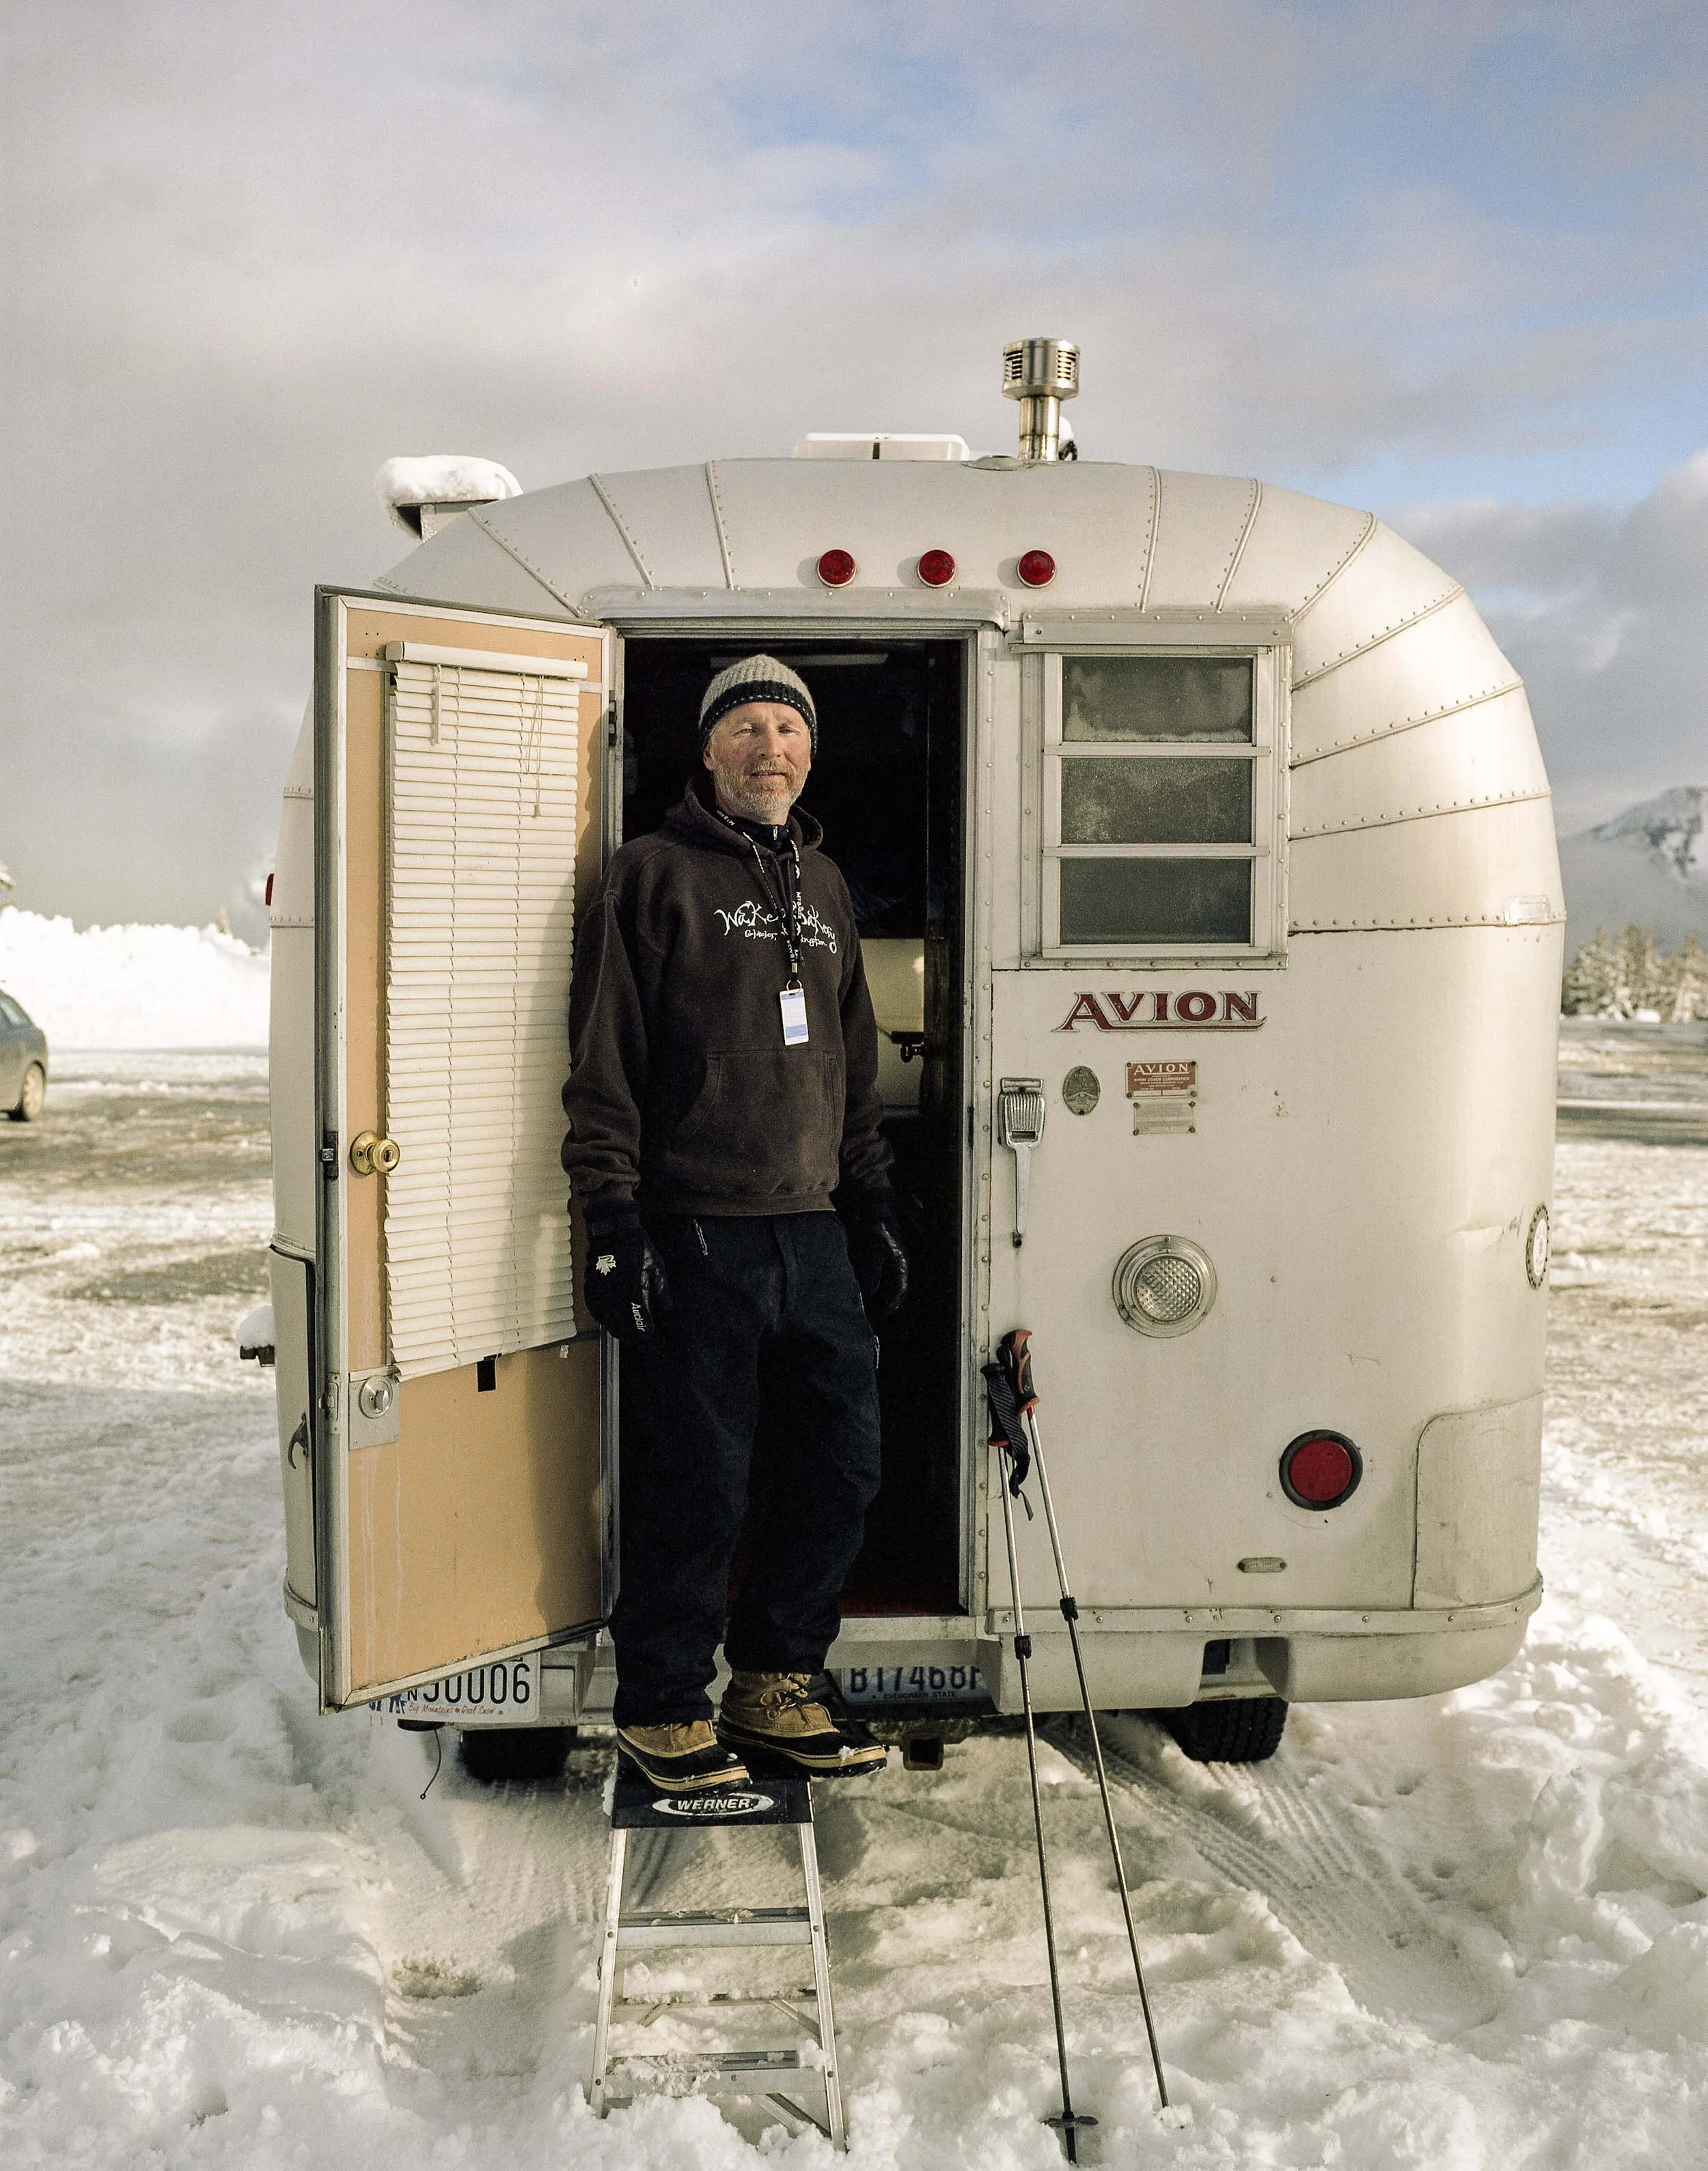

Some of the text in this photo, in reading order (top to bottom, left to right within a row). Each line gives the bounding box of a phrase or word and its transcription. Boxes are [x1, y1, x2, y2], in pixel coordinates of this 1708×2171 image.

[801, 935, 827, 947] ington
[1051, 991, 1267, 1032] AVION
[1133, 1063, 1190, 1075] AVION
[631, 1302, 646, 1332] Auclair
[677, 1798, 750, 1810] WERNER
